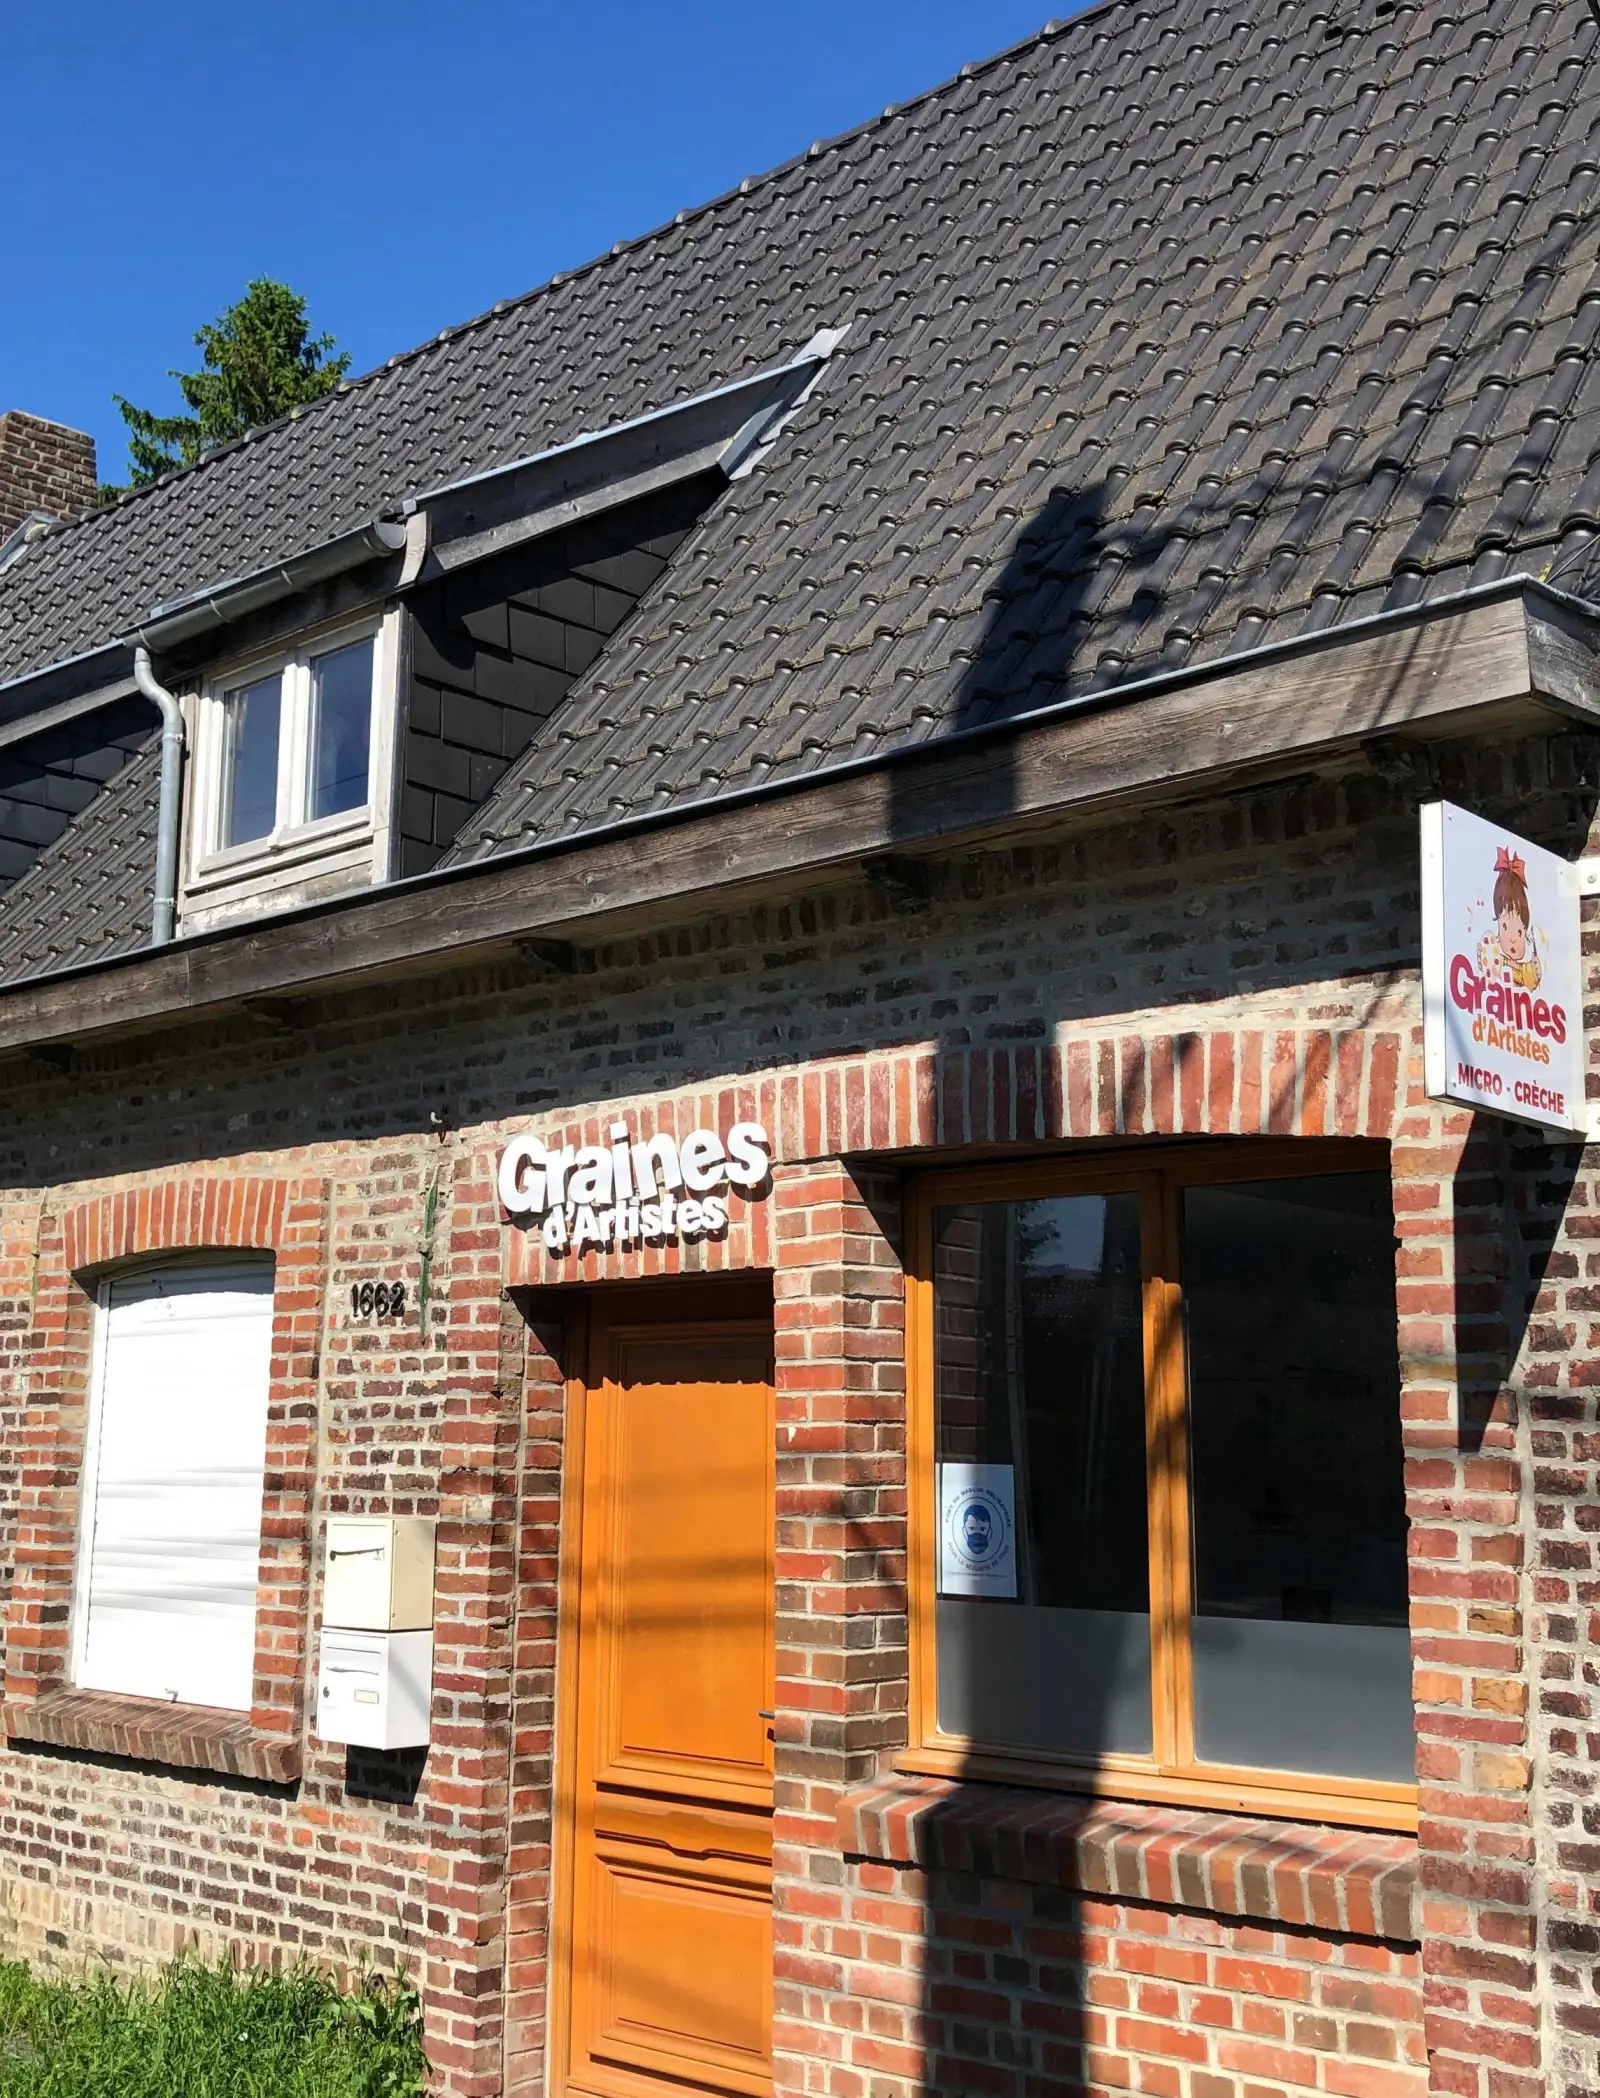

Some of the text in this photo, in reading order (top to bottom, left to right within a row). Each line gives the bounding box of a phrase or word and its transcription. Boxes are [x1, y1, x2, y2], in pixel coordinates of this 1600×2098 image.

[1450, 954, 1567, 1044] Graines
[1472, 1014, 1550, 1065] d'Artistes
[1458, 1063, 1503, 1096] MICRO
[1514, 1079, 1564, 1115] CRÈCHE
[499, 1120, 769, 1213] Graines
[543, 1193, 725, 1248] d'Artistes
[351, 1281, 405, 1318] 1662
